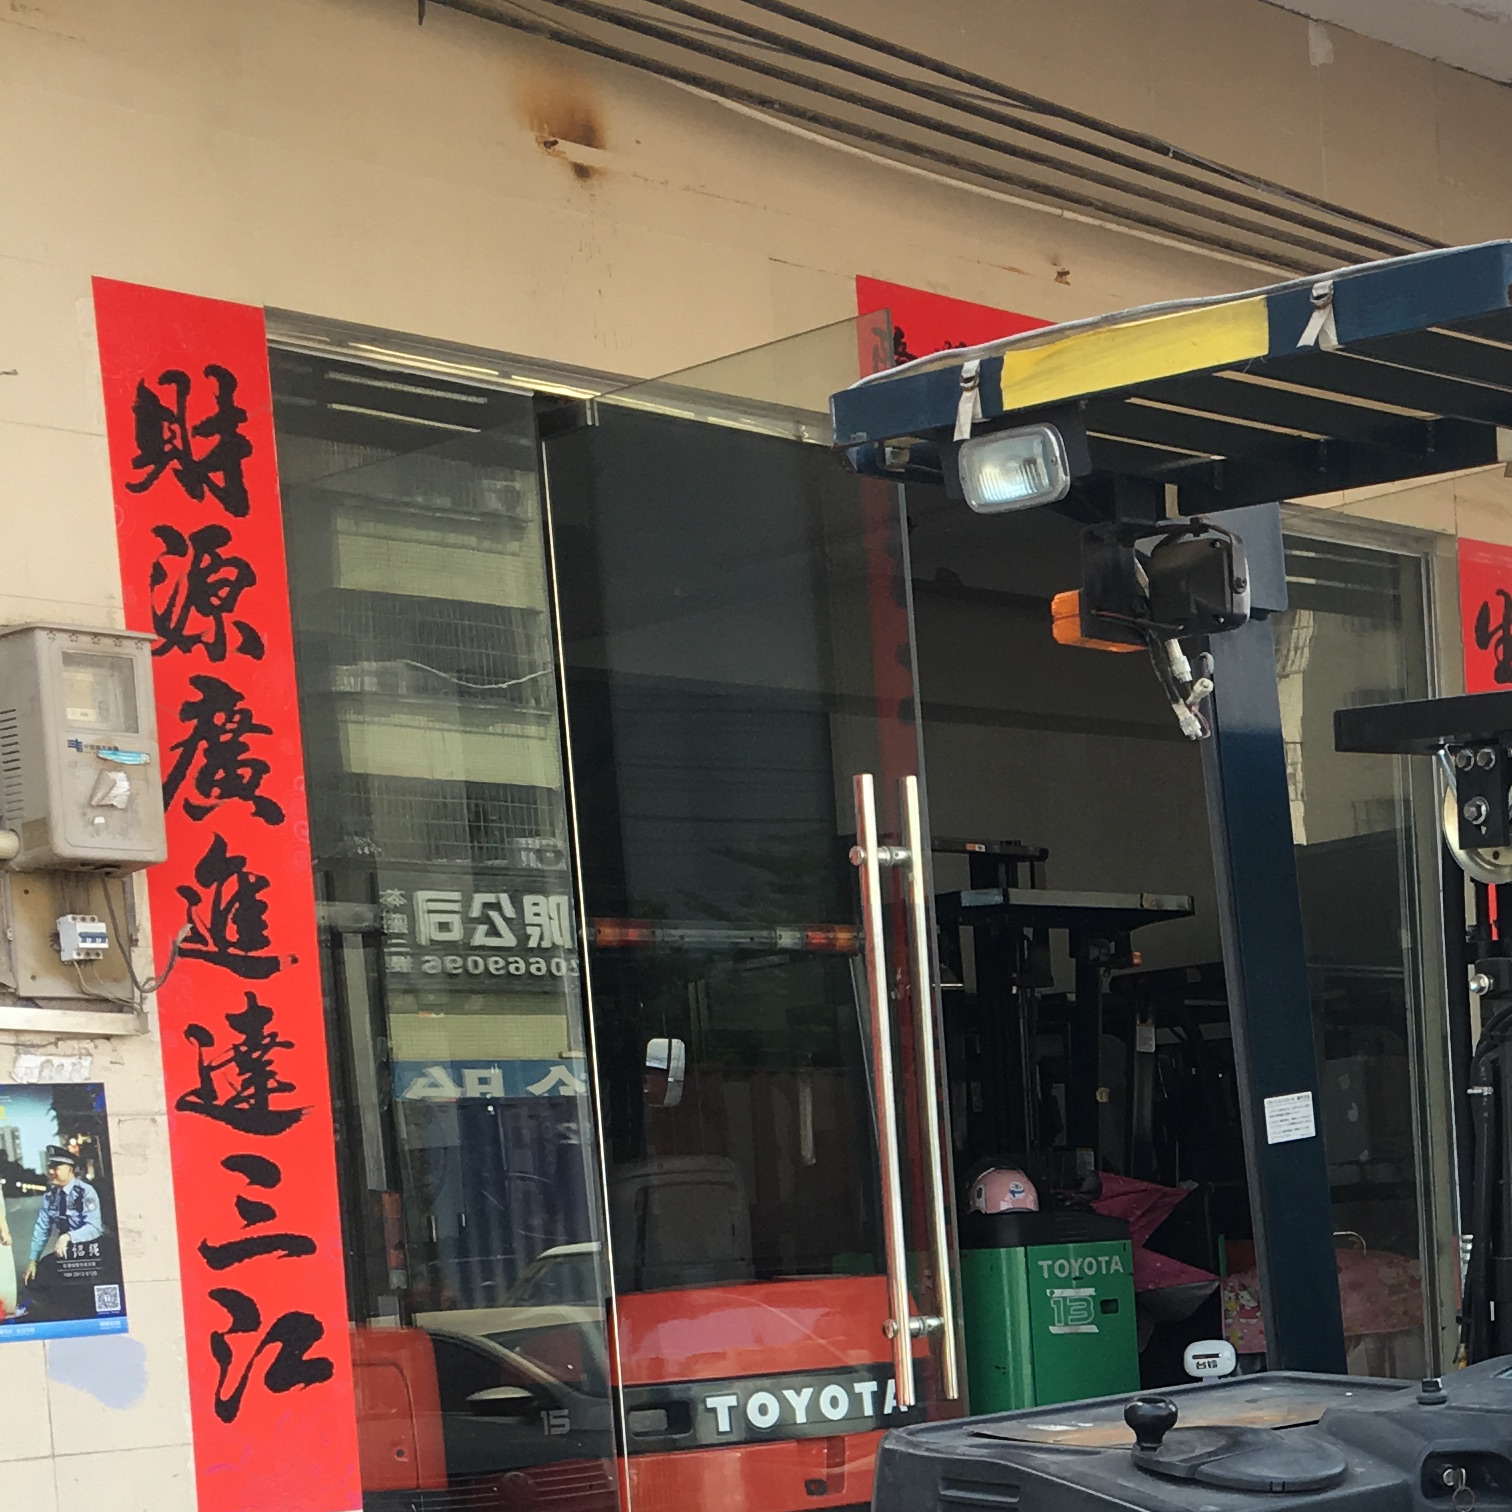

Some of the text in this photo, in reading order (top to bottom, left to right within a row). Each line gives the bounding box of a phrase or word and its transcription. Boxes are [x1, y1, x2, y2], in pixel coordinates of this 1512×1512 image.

[1038, 1255, 1124, 1279] TOYOTA
[706, 1380, 908, 1433] TOYOTA
[540, 1409, 571, 1435] 15
